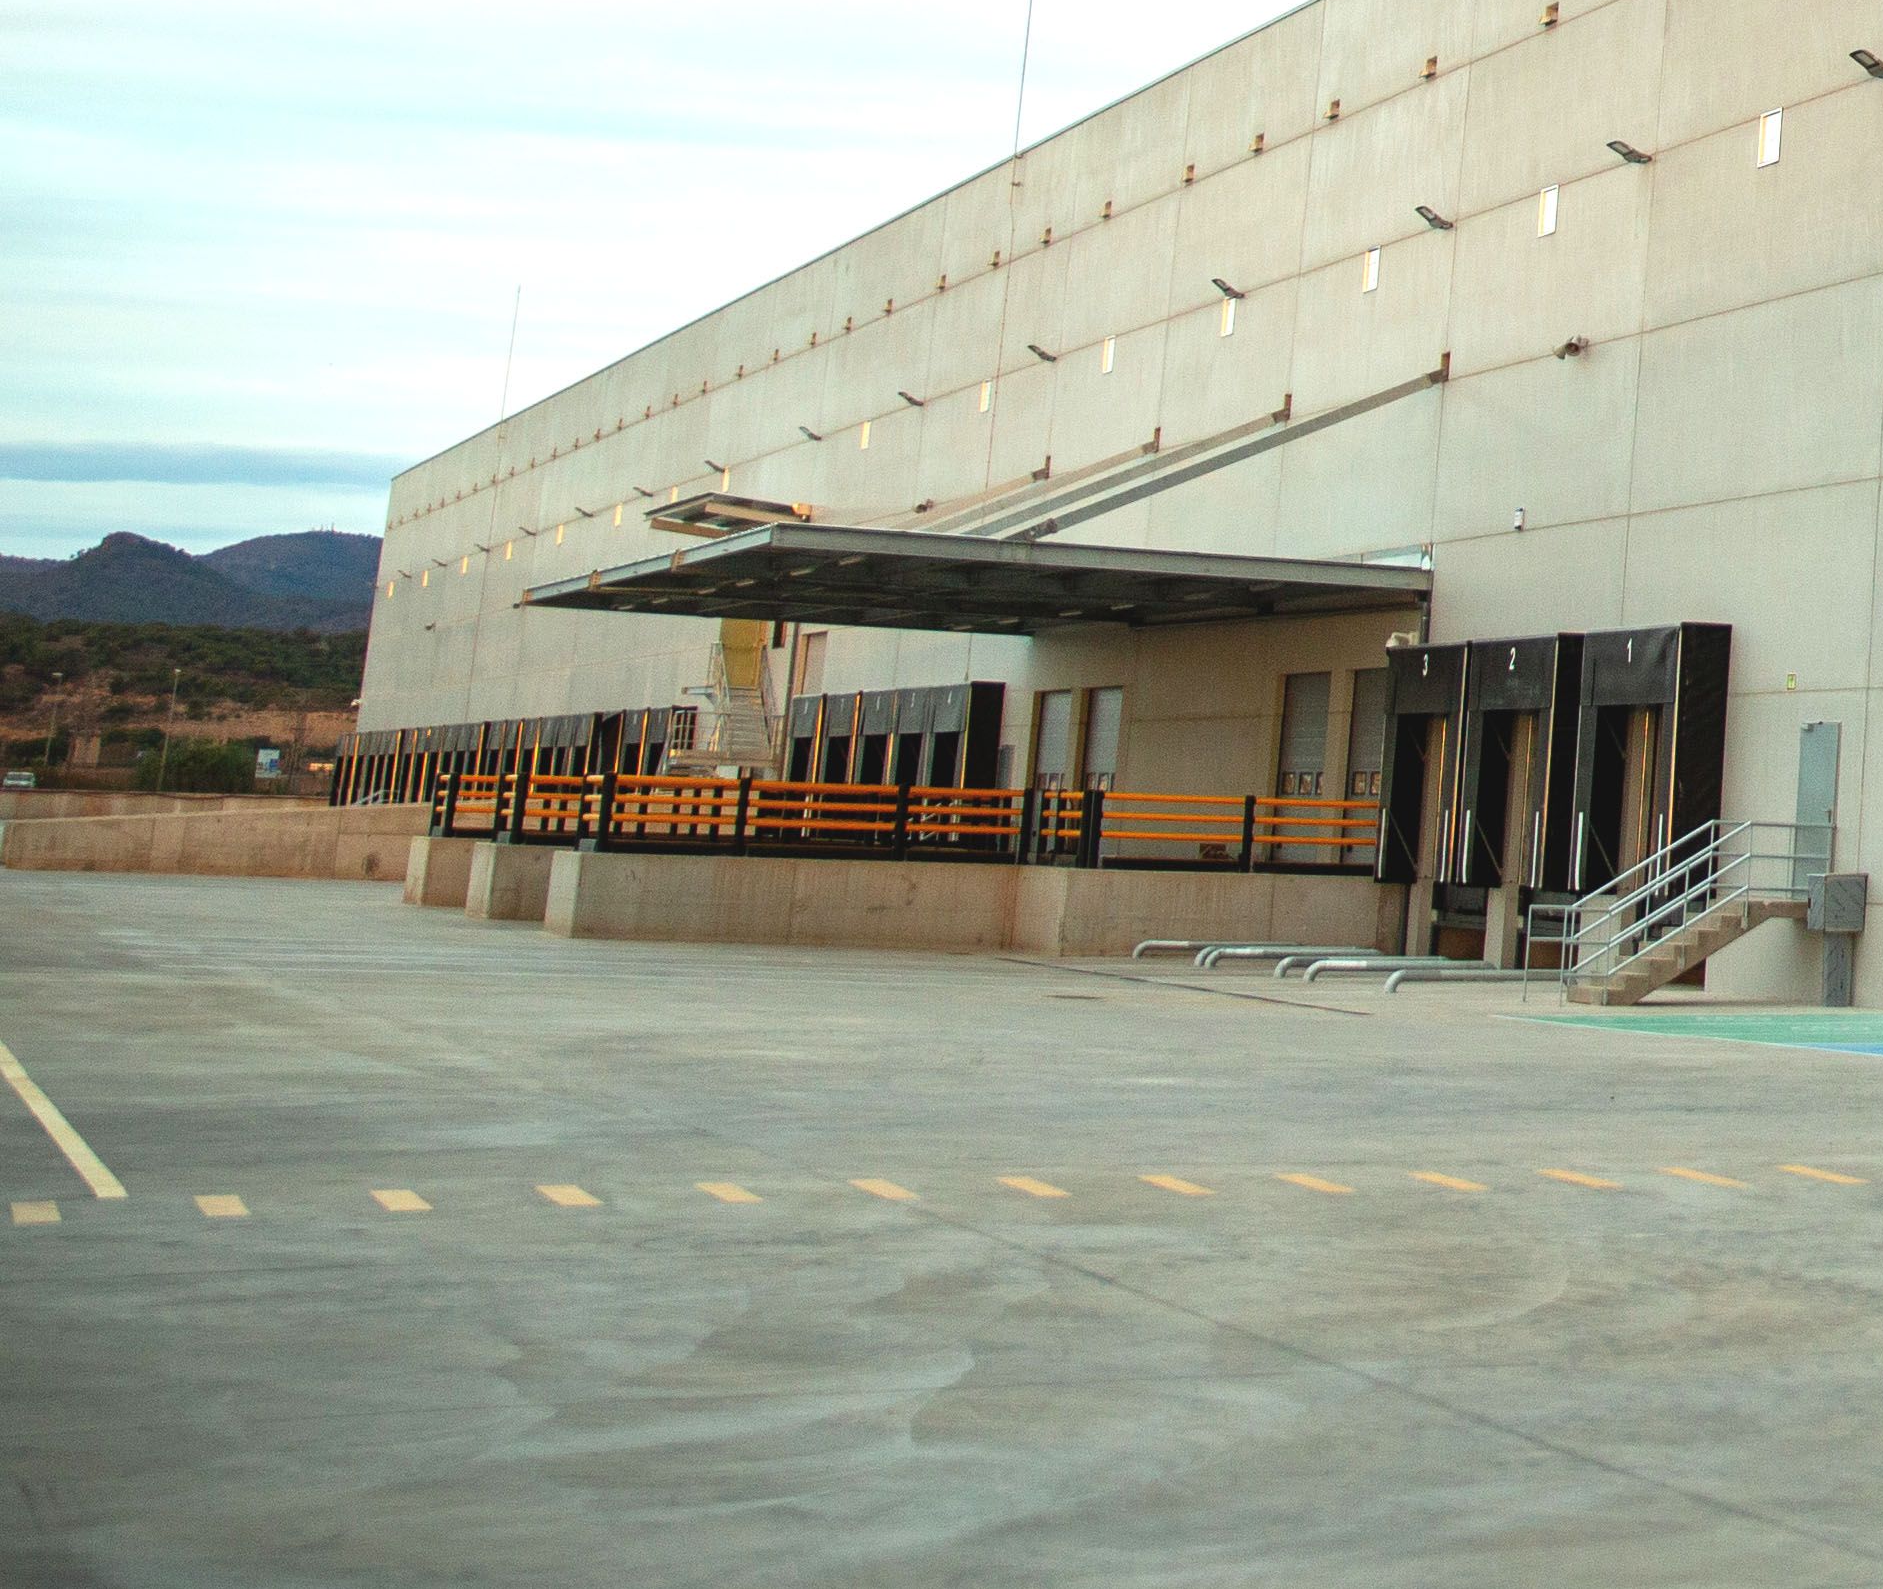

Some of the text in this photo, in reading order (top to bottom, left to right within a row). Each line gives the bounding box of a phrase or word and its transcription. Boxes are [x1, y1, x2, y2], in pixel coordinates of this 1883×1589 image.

[1509, 646, 1516, 670] 2
[1626, 637, 1633, 663] 1
[1422, 653, 1429, 677] 3
